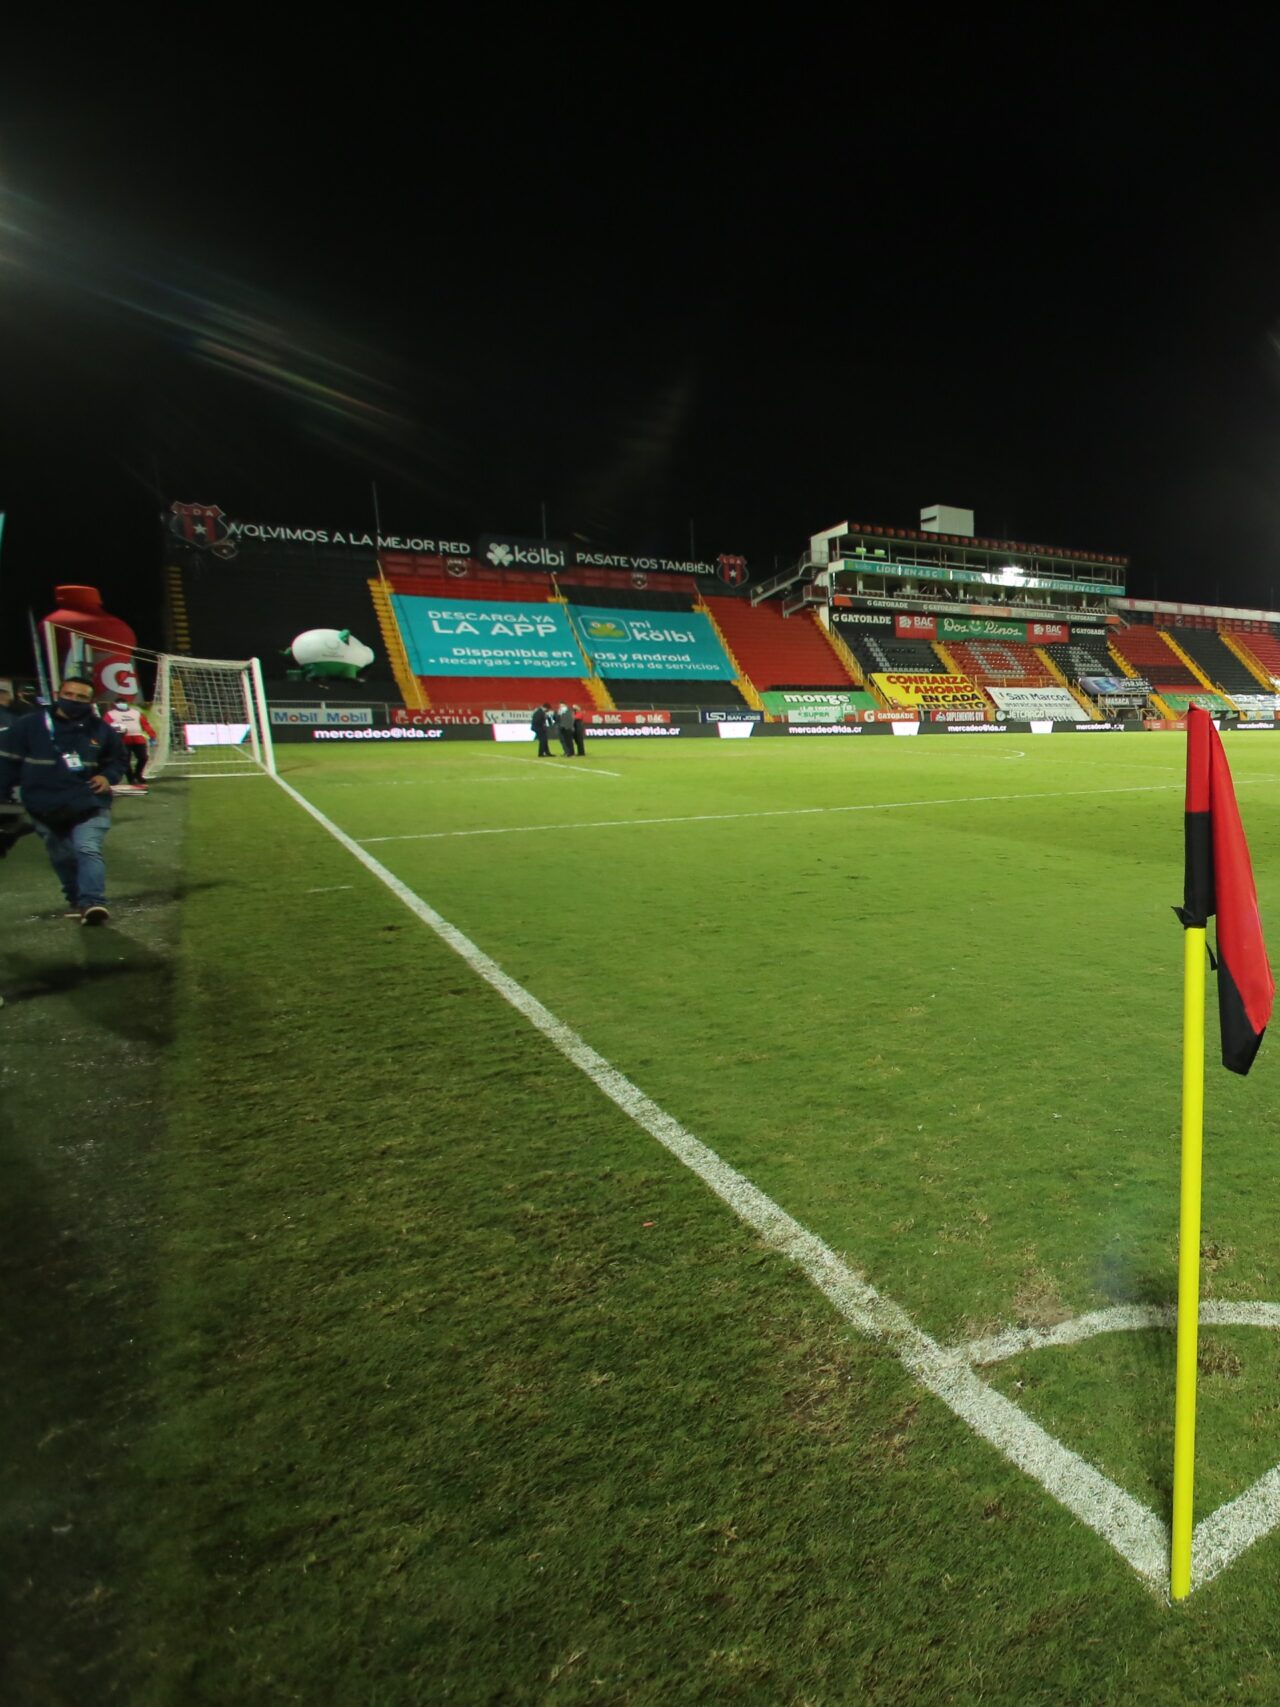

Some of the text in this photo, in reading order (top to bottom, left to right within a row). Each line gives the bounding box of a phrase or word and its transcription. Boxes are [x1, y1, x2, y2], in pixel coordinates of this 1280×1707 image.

[230, 523, 471, 554] VOLVIMOS A LA MEJOR RED
[514, 545, 566, 567] kölbi
[576, 552, 715, 575] PASATE VOS TAMBIÉN
[873, 600, 909, 609] GATORADE
[427, 610, 556, 624] DESCARGÁ YA
[840, 613, 892, 625] GATORADE
[914, 616, 934, 627] BAC
[431, 620, 558, 638] LA APP
[629, 620, 652, 629] mi
[943, 617, 1023, 636] Dos Pinos
[1045, 624, 1062, 634] BAC
[631, 628, 696, 643] kölbi
[1076, 627, 1106, 636] GATORADE
[452, 647, 574, 660] Disponible en
[618, 652, 629, 661] y
[631, 653, 691, 662] Android
[439, 656, 568, 668] Recargas Pagos
[664, 663, 720, 671] servicios
[101, 662, 139, 696] G
[886, 674, 970, 685] CONFIANZA
[901, 684, 975, 695] Y AHORRO
[784, 694, 850, 706] monge
[921, 693, 981, 703] EN CADA
[1006, 692, 1070, 701] San Marcos
[273, 711, 318, 722] Mobil
[327, 712, 368, 722] Mobil
[412, 715, 480, 725] CASTILLO
[604, 714, 622, 723] BAC
[877, 711, 915, 720] GATORADE
[314, 727, 443, 739] mercadeo@lda.cr
[585, 726, 681, 737] mercadeo@lda.cr
[788, 724, 863, 734] mercadeo@lda.cr
[948, 724, 1007, 732] mercadeo@lda.cr
